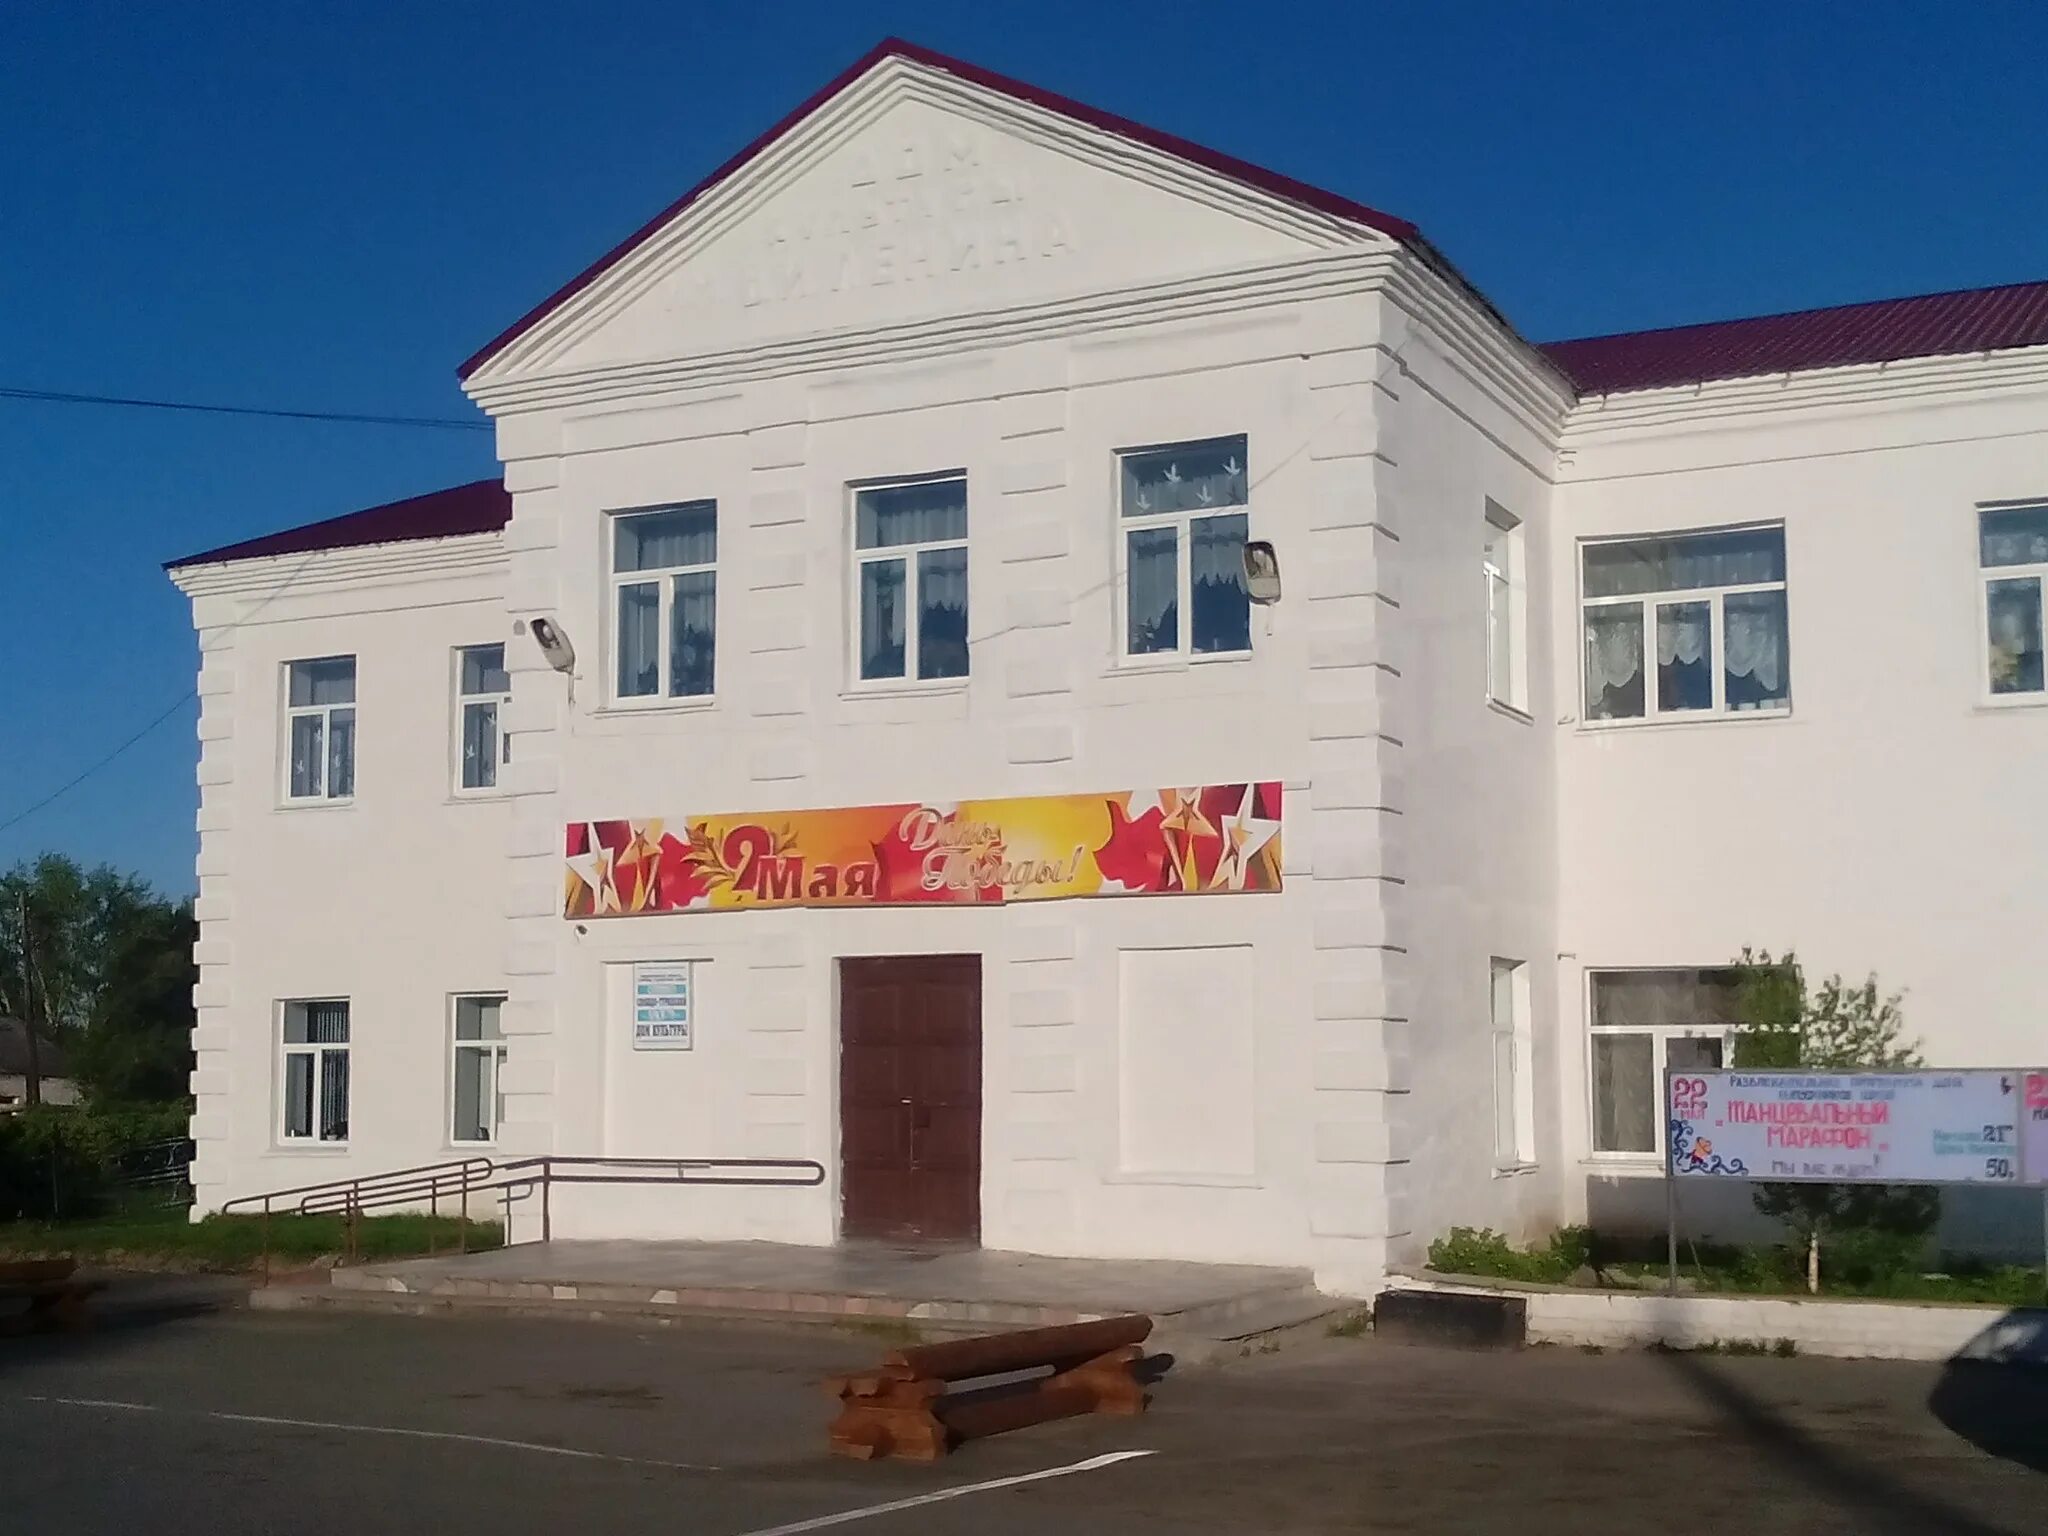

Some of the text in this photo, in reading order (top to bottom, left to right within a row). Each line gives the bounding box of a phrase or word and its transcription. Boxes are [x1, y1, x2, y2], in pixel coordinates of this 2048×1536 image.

[722, 824, 881, 901] 9 Мая
[1674, 1078, 1708, 1109] 22
